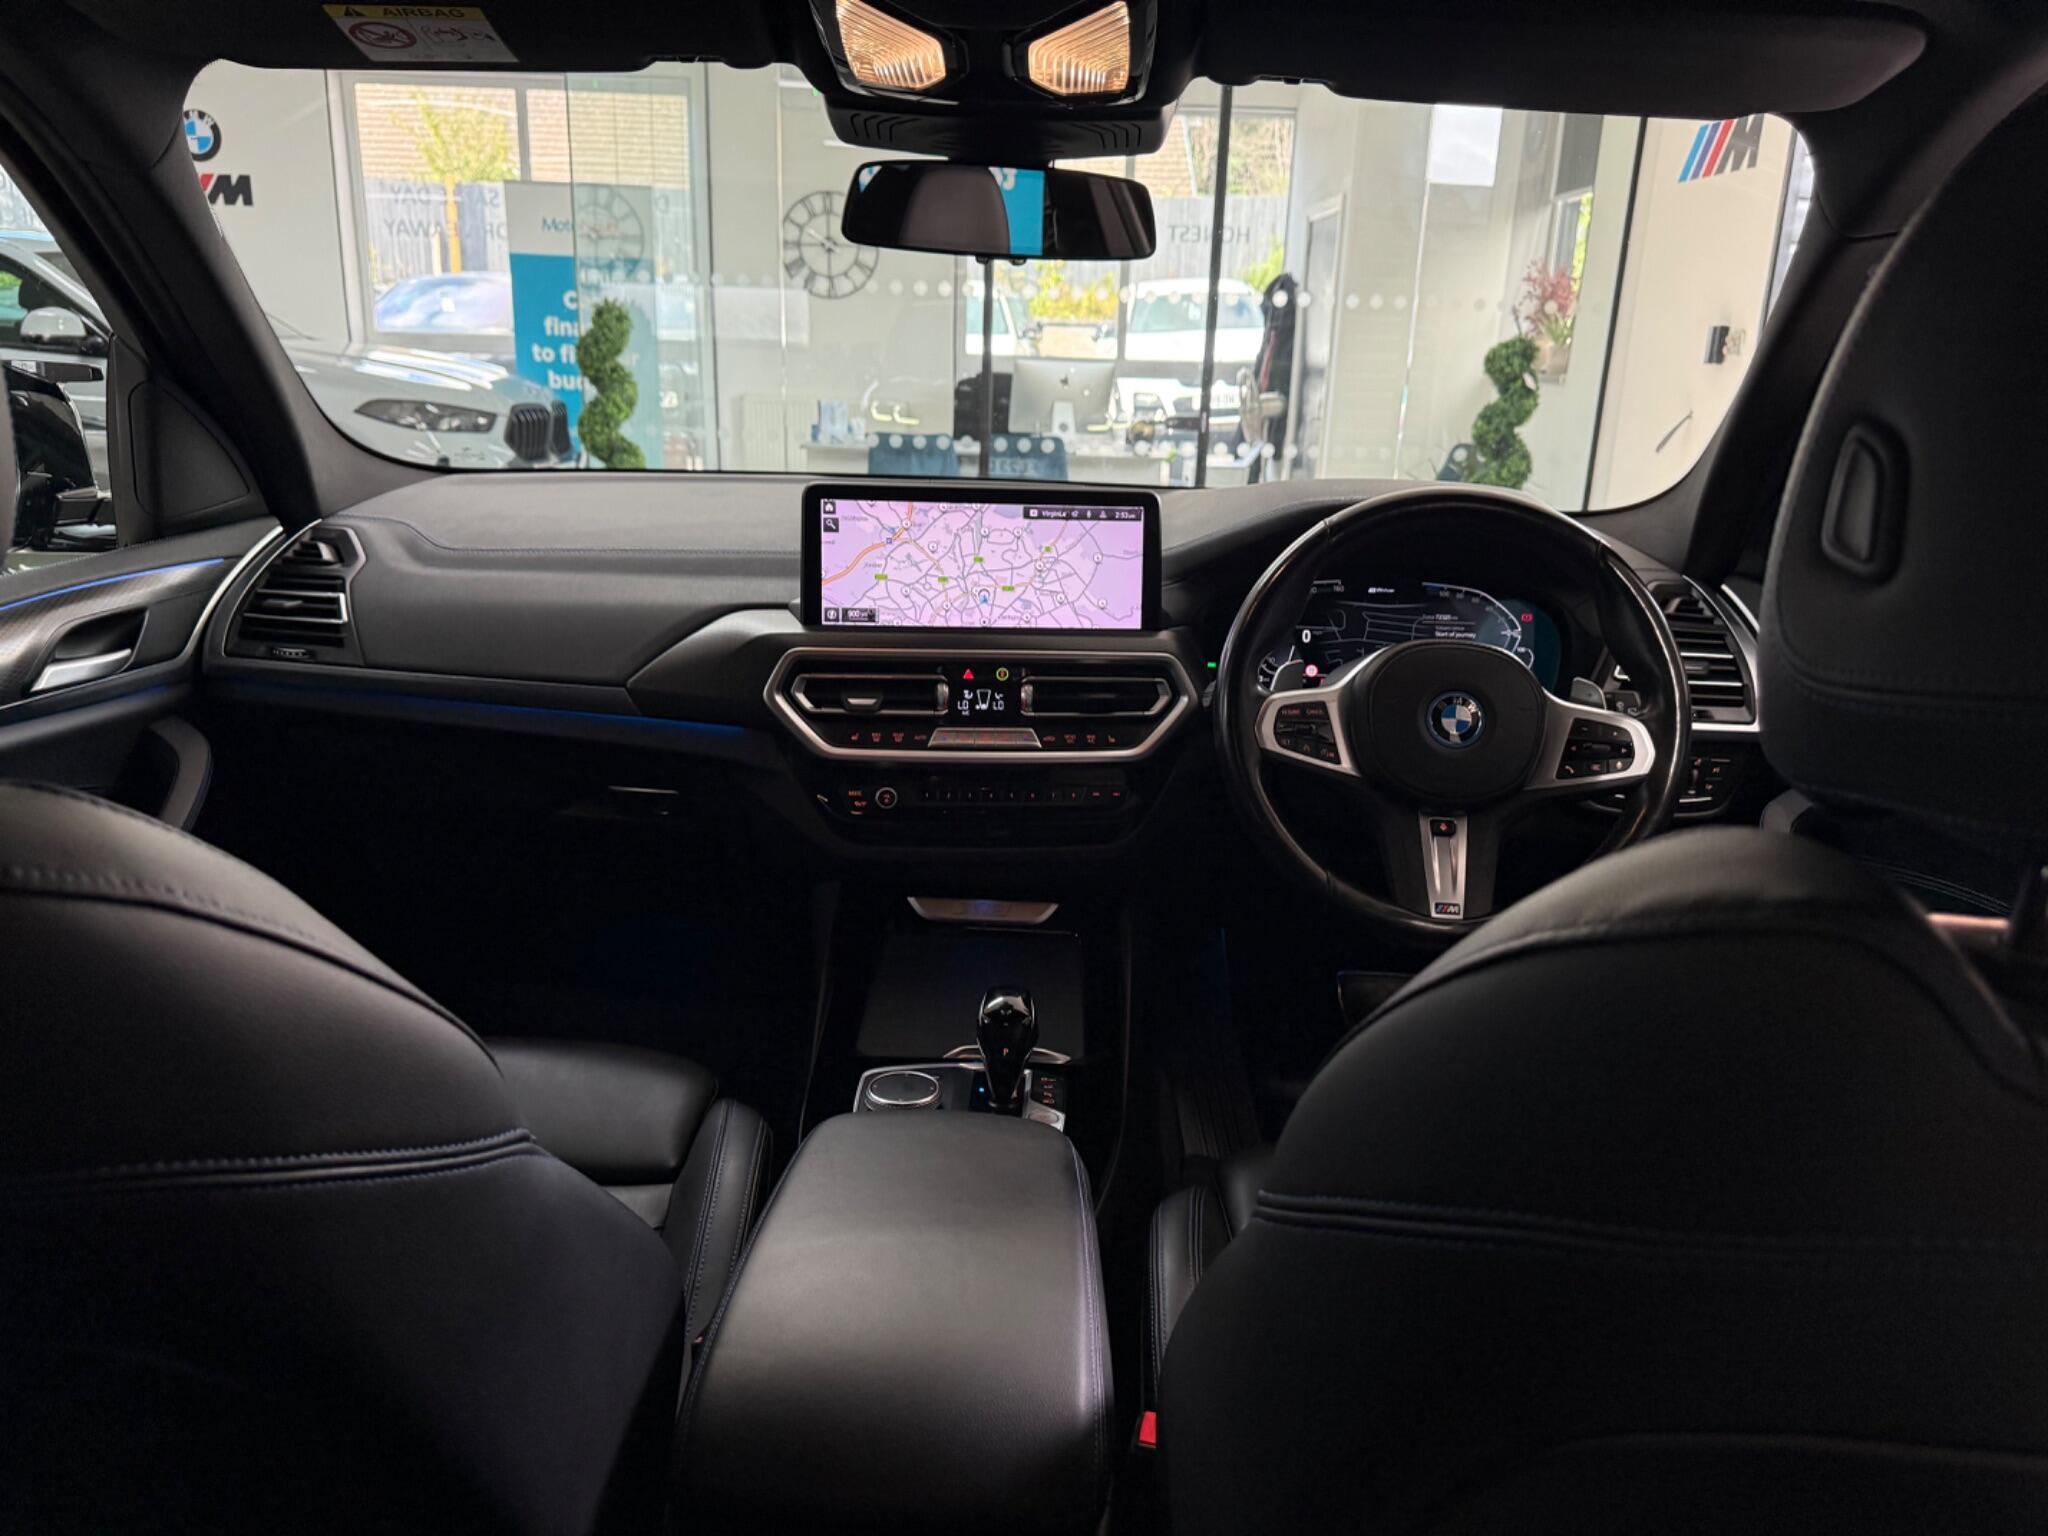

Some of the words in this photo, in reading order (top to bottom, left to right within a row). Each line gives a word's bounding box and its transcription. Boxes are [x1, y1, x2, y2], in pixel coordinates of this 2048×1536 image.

[383, 6, 465, 18] AIRBAG
[532, 343, 556, 363] to
[1302, 629, 1311, 643] 0
[1455, 632, 1477, 641] journey
